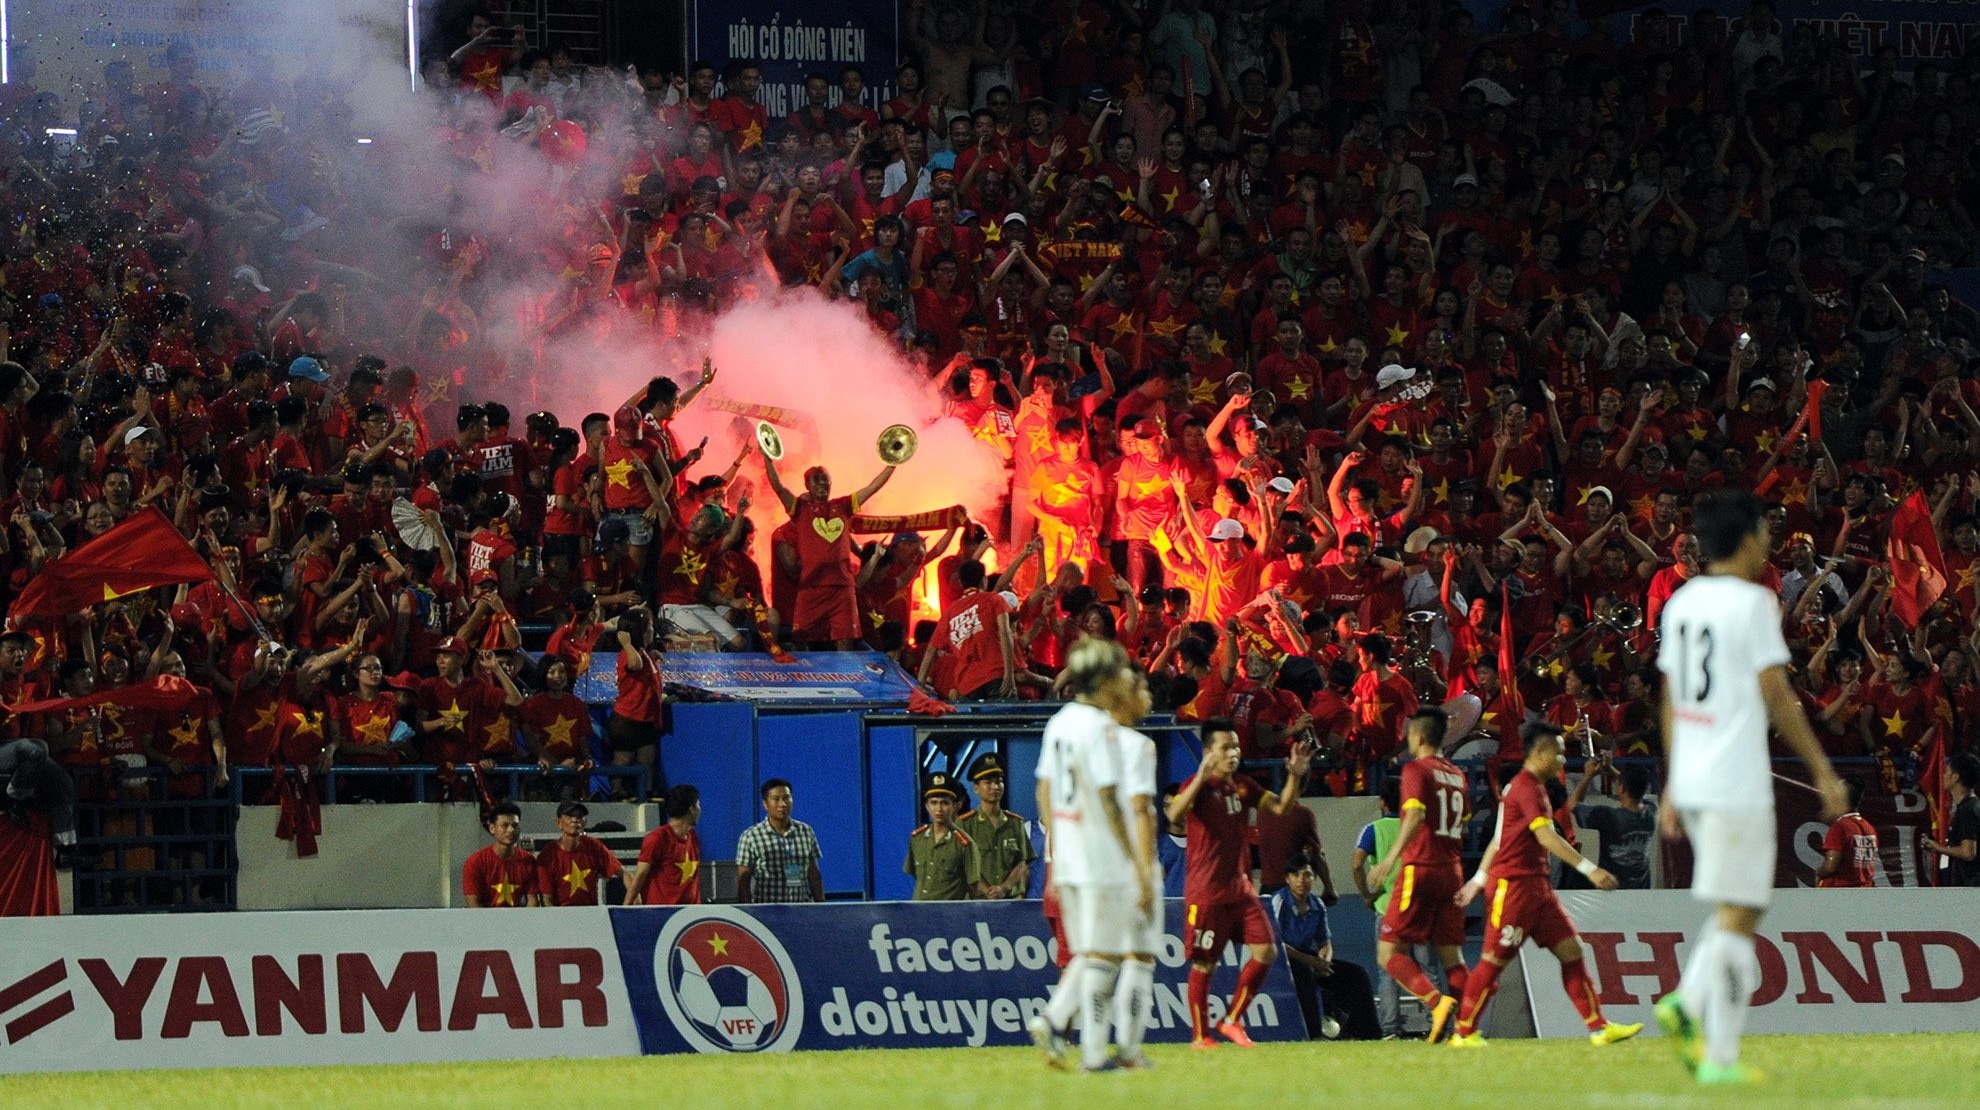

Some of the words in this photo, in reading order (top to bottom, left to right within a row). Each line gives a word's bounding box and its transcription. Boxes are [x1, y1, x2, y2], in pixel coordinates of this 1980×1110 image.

[759, 12, 780, 60] CỔ
[784, 19, 826, 68] ĐỘNG
[830, 21, 865, 62] VIÊN
[862, 516, 902, 530] VIET
[905, 511, 940, 528] NAM
[1676, 620, 1715, 703] 13
[1224, 793, 1243, 814] 16
[1435, 787, 1464, 840] 12
[868, 920, 1252, 974] faceboo
[1193, 929, 1216, 951] 16
[77, 946, 609, 1041] YANMAR
[721, 1016, 758, 1037] VFF
